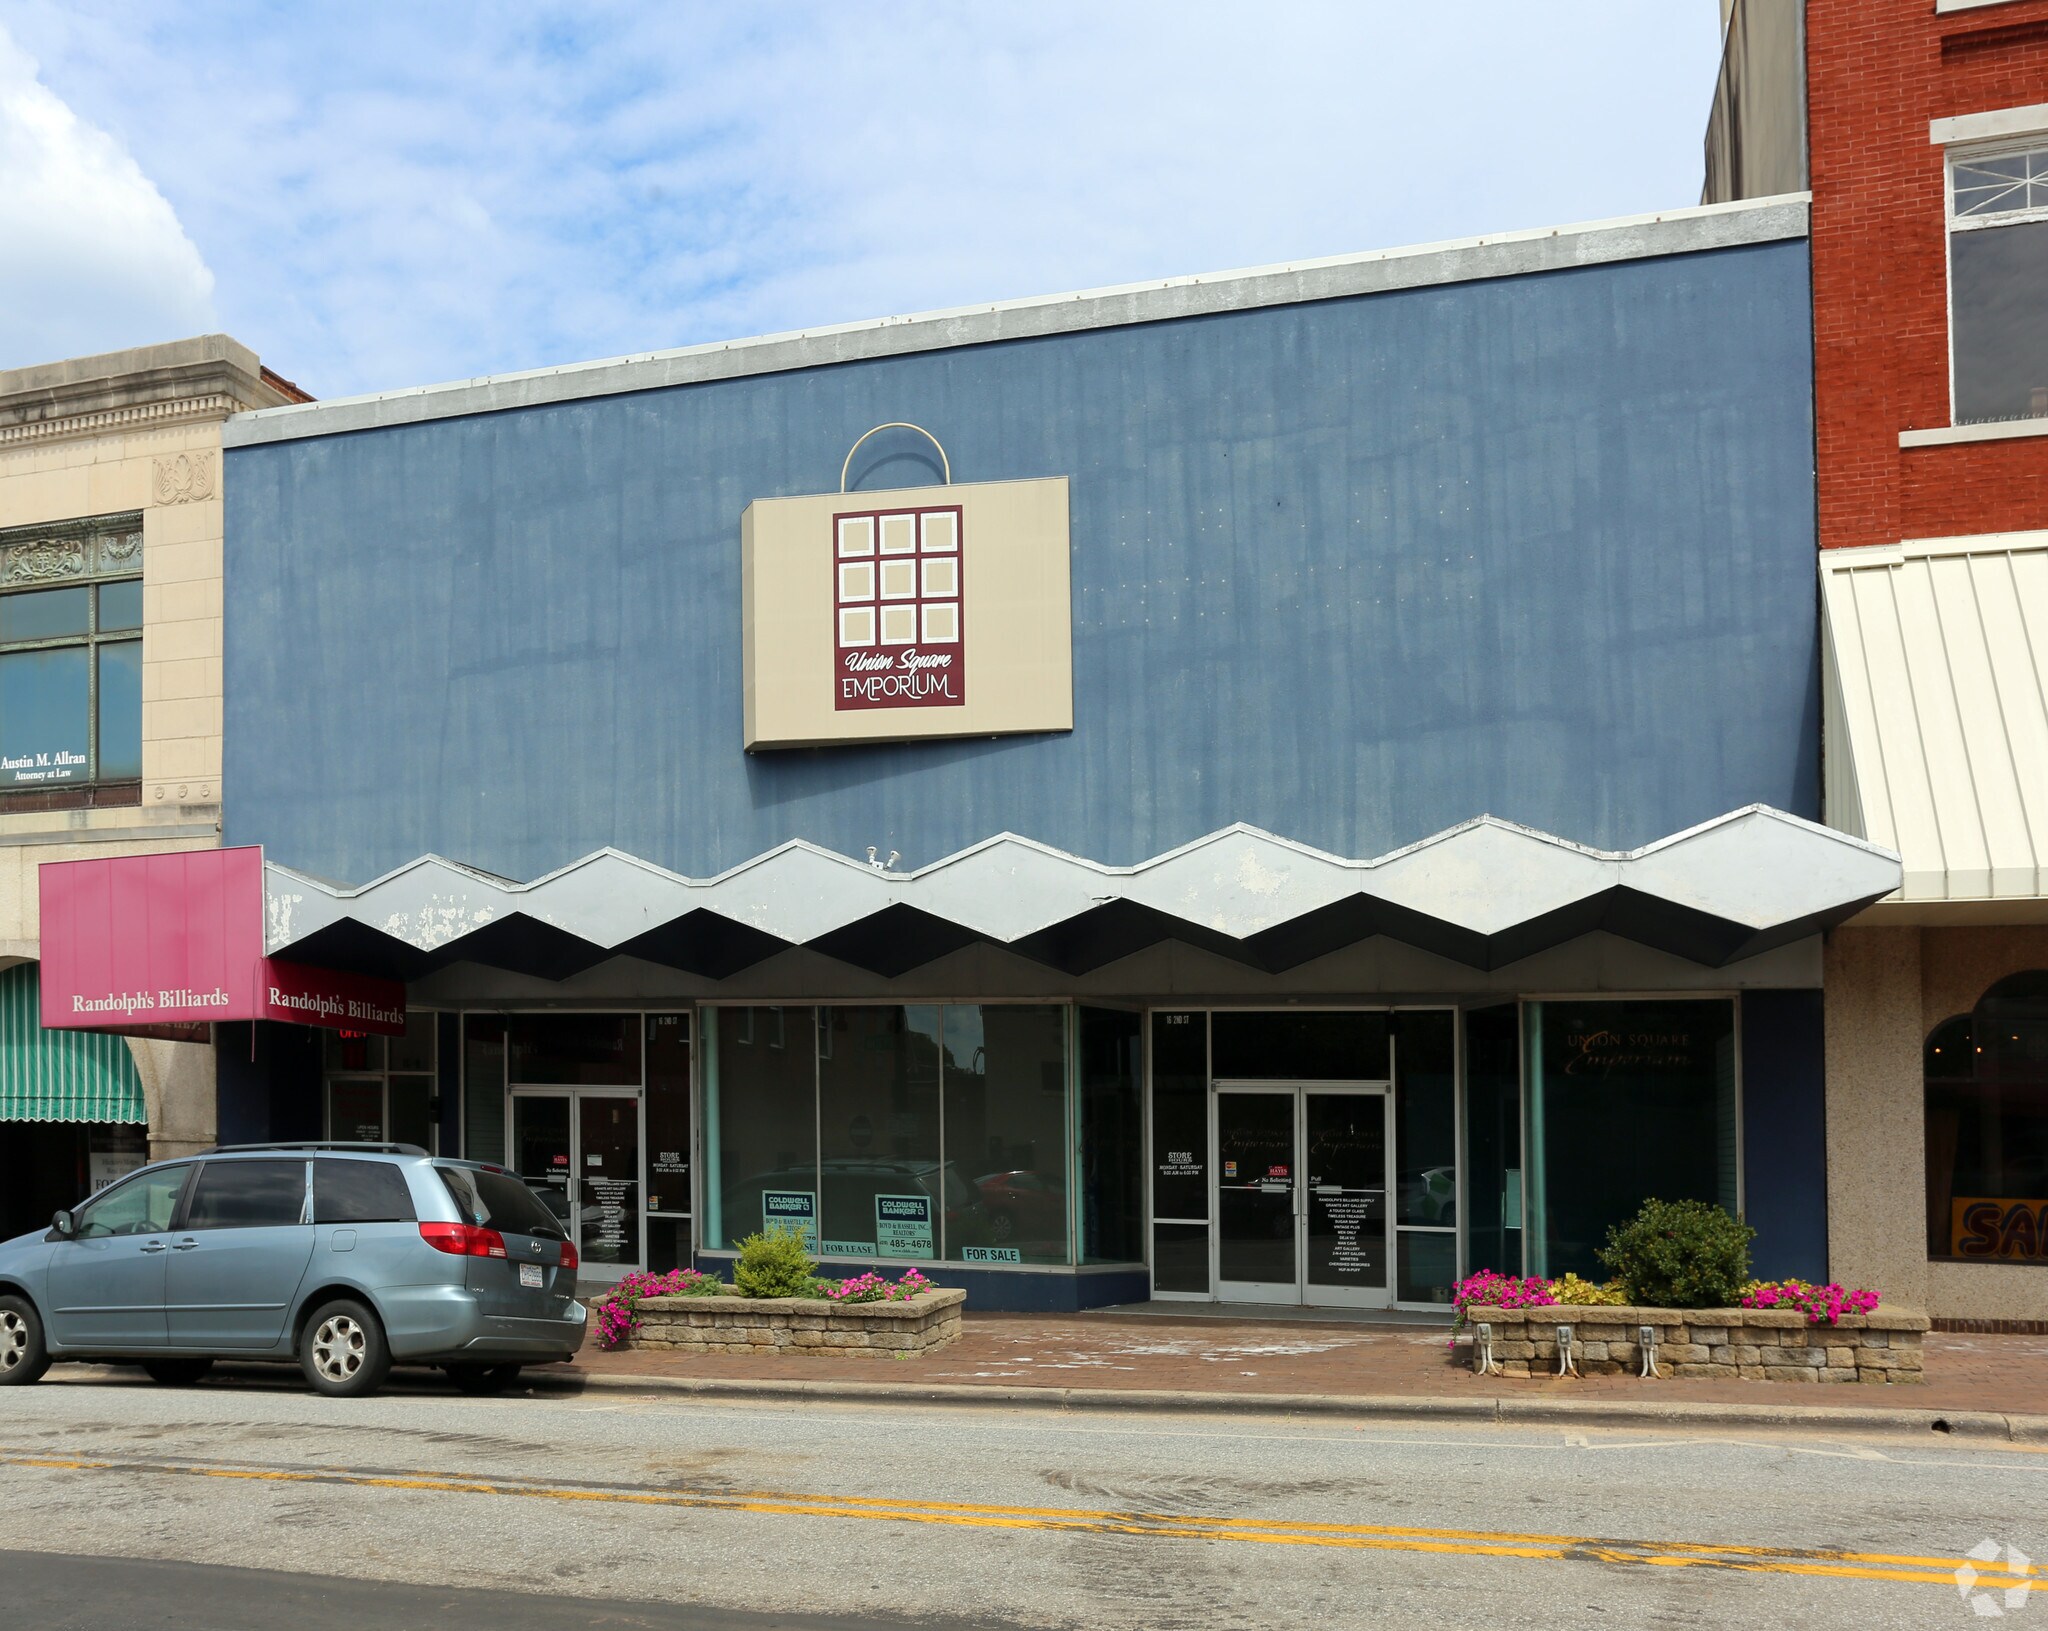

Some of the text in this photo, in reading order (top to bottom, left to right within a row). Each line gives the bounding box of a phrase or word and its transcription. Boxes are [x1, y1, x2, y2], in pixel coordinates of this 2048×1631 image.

[845, 648, 952, 677] Union Square
[842, 673, 958, 701] EMPORIUM
[1, 750, 86, 770] Austin M. Allran
[15, 769, 72, 781] Attorney at Law
[72, 988, 229, 1016] Randolph's Billiards
[269, 987, 404, 1025] Randolph's Billiards
[1568, 1034, 1689, 1048] UNION SQUARE
[768, 1196, 810, 1205] COLDWELL
[881, 1201, 924, 1209] COLDWELL
[769, 1203, 802, 1211] BANKER
[883, 1207, 917, 1216] BANKER
[1959, 1203, 2048, 1258] SA
[825, 1244, 844, 1253] FOR
[845, 1246, 874, 1254] LEASE
[890, 1239, 932, 1249] 485-4678
[966, 1249, 1017, 1261] FOR SALE
